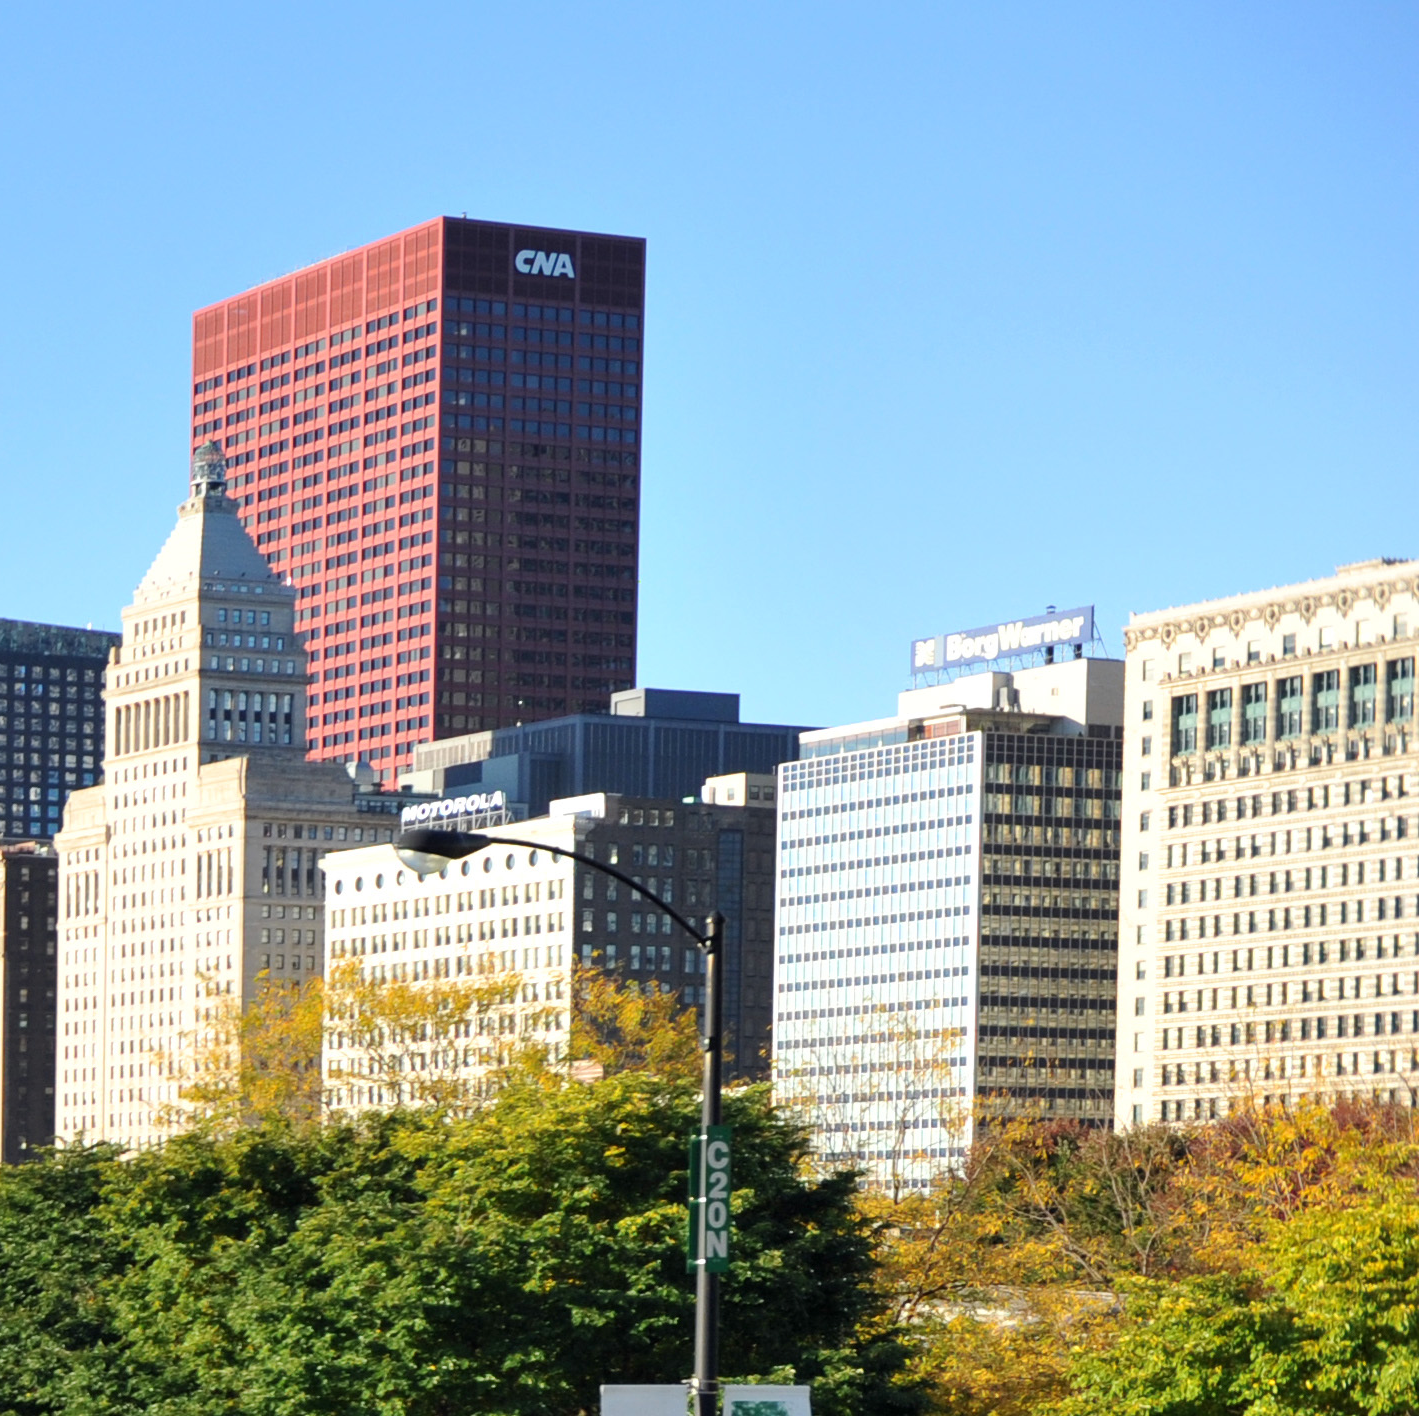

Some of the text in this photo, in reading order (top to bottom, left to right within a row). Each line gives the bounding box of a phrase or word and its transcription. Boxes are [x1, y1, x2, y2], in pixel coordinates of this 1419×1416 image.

[514, 249, 576, 279] CNA
[946, 615, 1084, 662] BorgWarner
[401, 791, 503, 823] MOTOROLA
[706, 1140, 730, 1260] C20N
